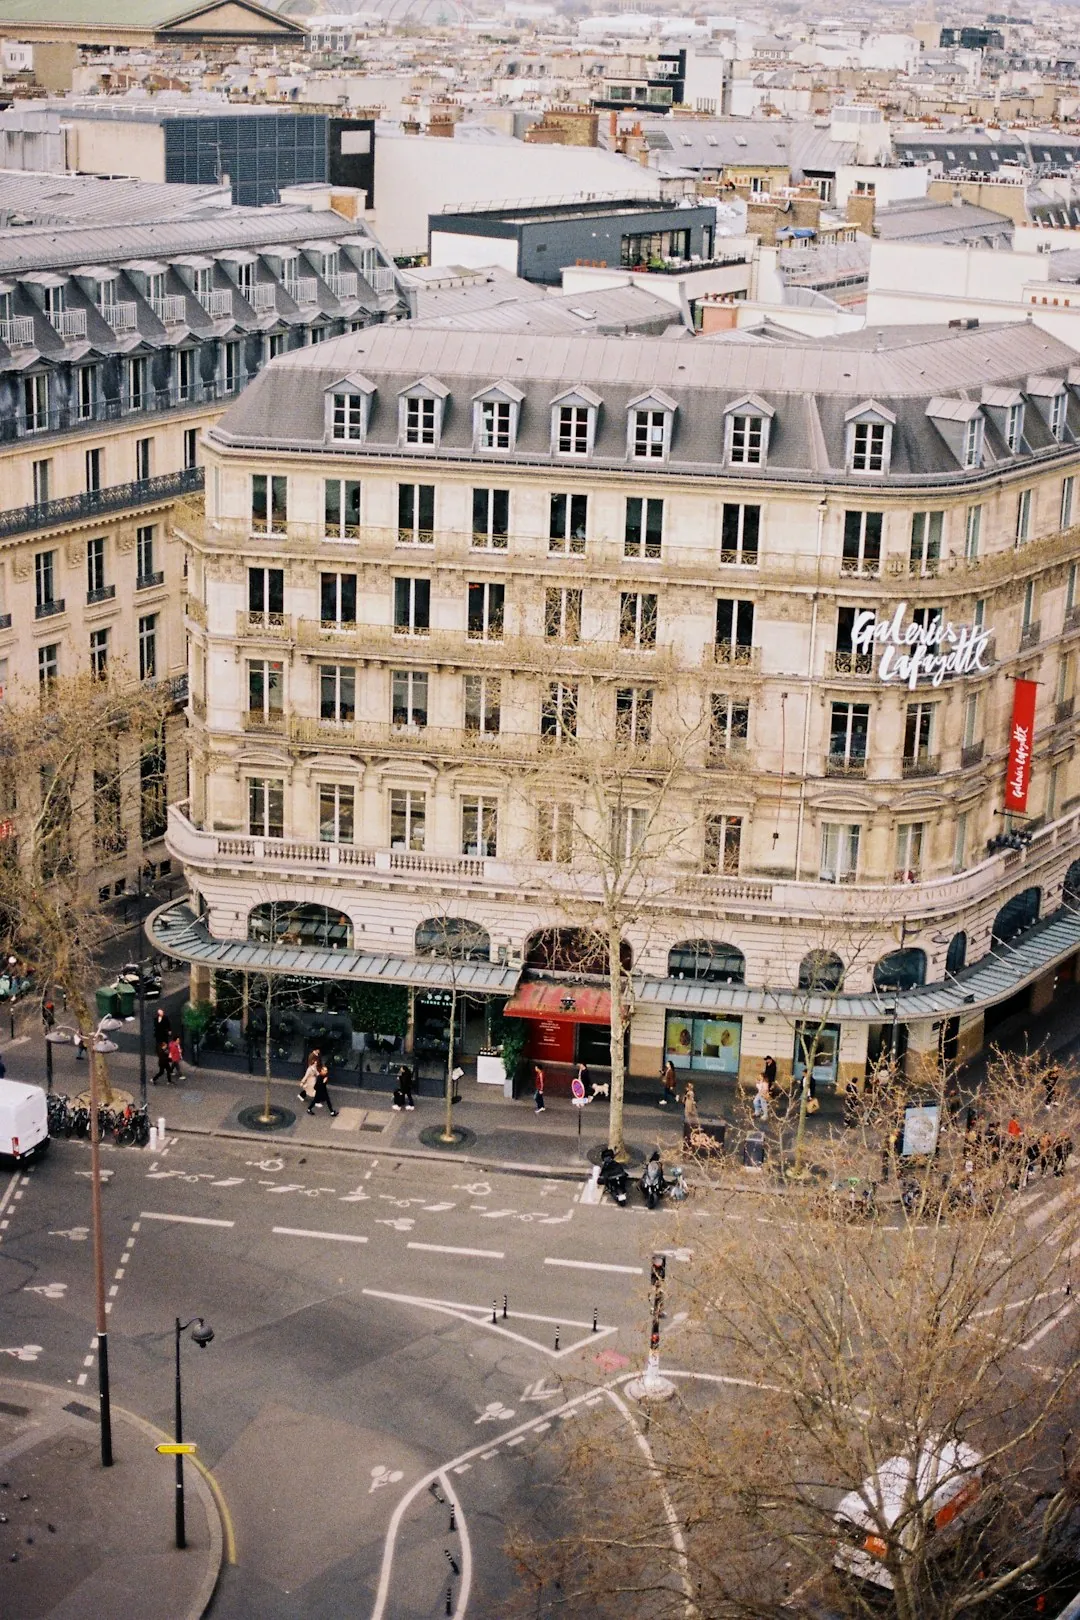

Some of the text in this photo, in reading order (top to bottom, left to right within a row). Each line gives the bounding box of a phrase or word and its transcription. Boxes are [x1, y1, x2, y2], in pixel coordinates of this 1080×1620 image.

[851, 602, 957, 656] Galeries
[879, 625, 995, 691] Lafayette
[1010, 723, 1030, 798] Galeries Lafayette
